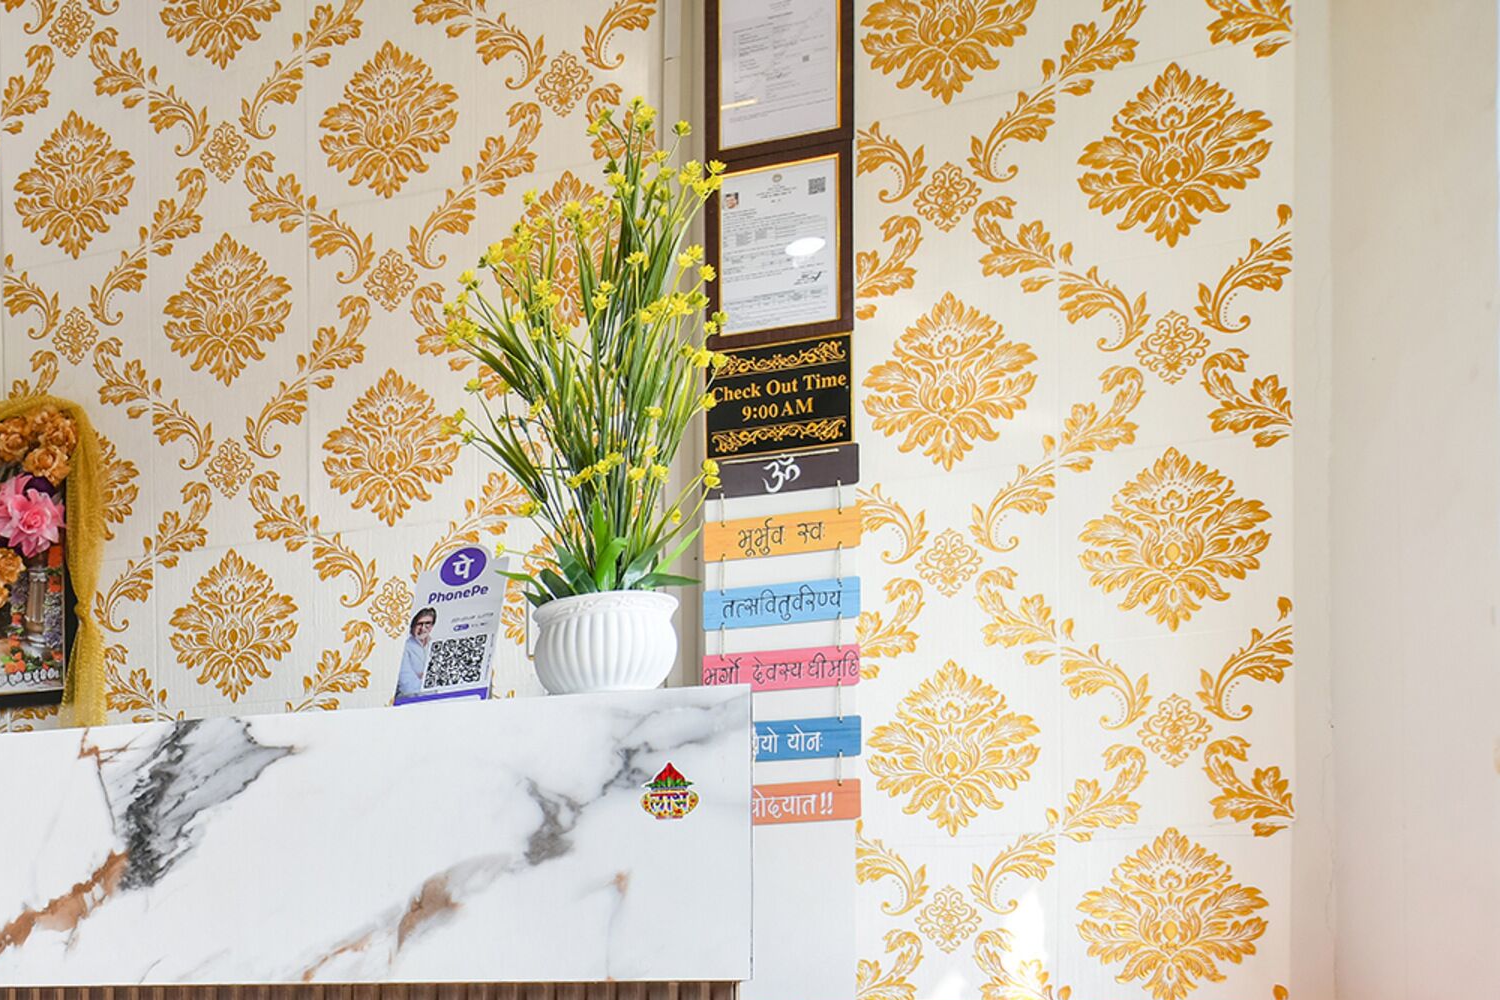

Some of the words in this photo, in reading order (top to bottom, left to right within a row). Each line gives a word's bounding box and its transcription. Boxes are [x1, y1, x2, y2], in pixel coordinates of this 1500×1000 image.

[710, 384, 762, 403] Check
[766, 379, 798, 397] Out
[803, 372, 848, 391] Time
[428, 584, 489, 604] PhonePe
